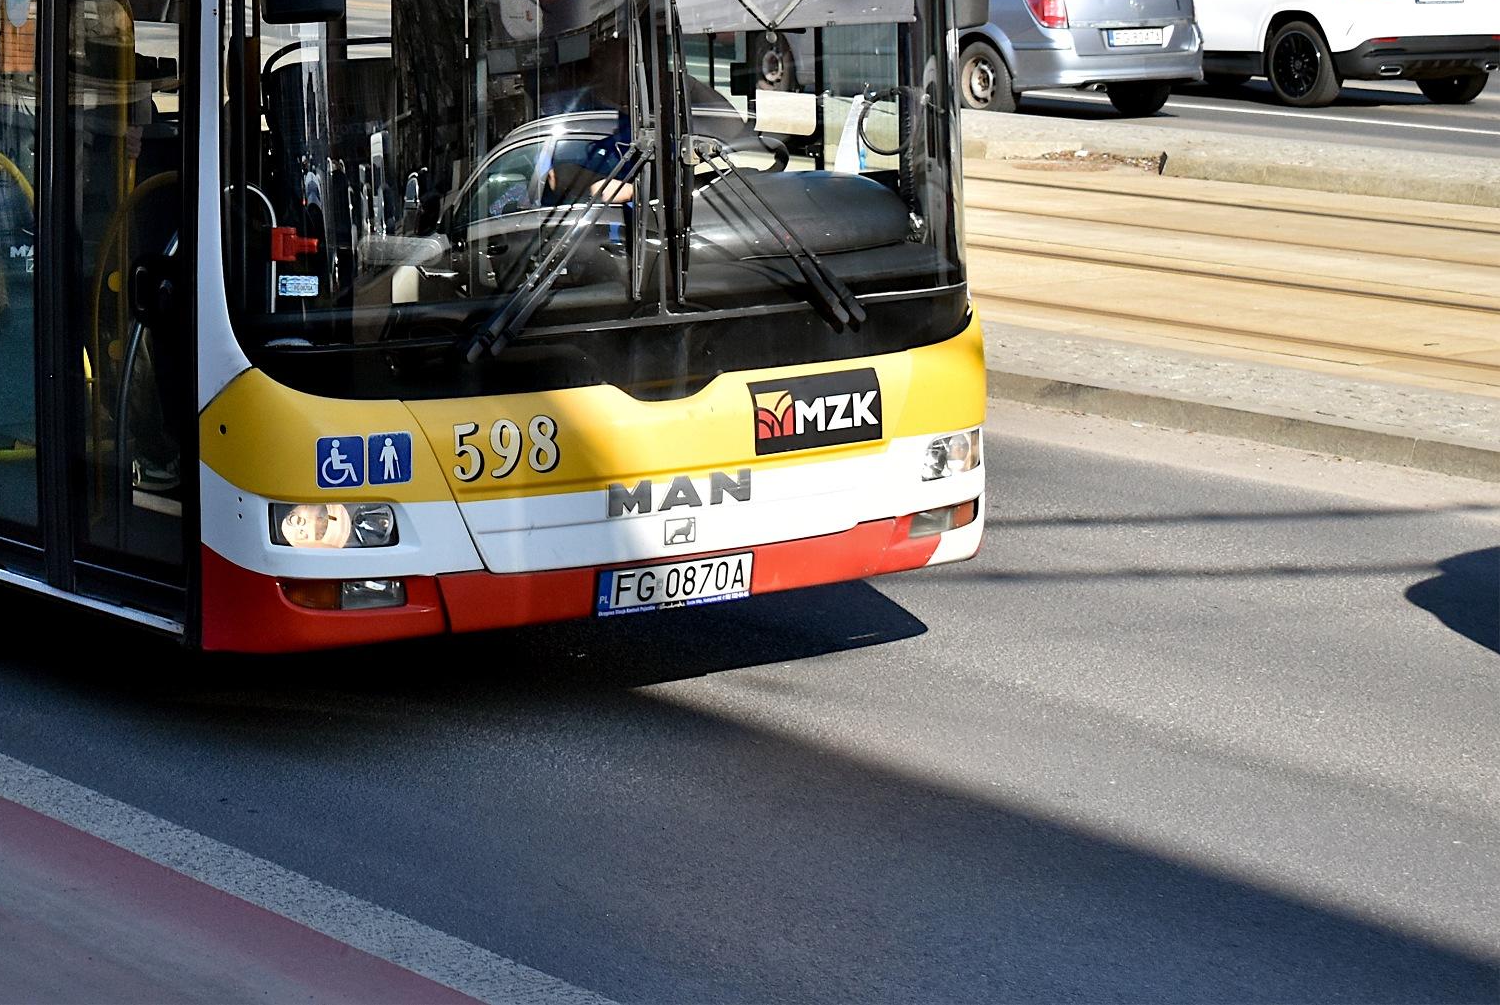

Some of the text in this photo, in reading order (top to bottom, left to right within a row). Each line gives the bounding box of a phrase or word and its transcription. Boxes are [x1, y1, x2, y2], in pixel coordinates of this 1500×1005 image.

[794, 390, 879, 435] MZK
[453, 414, 561, 483] 598
[607, 468, 752, 519] MAN
[599, 595, 609, 605] PL
[615, 570, 656, 606] FG
[665, 558, 745, 599] 0870A
